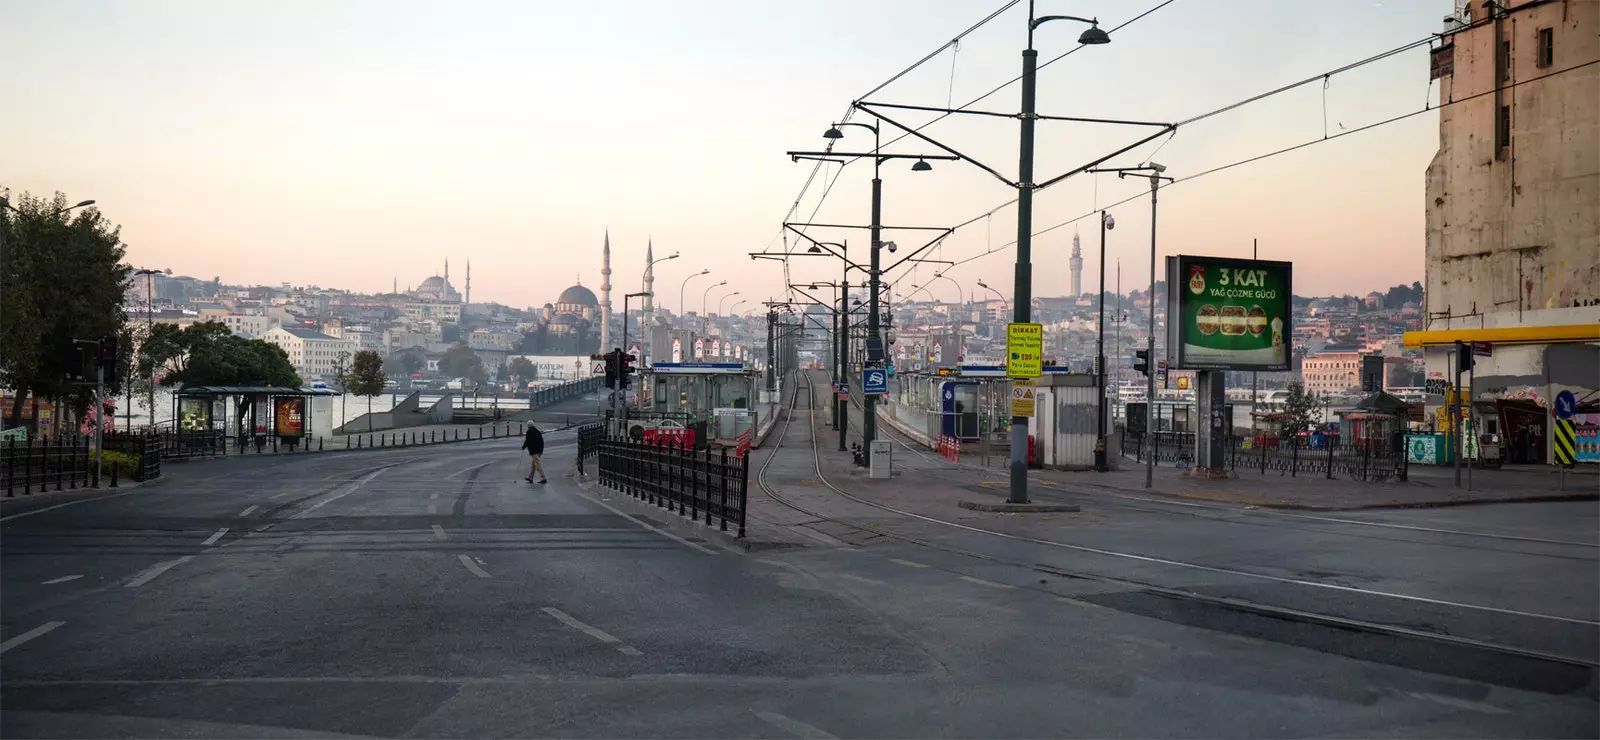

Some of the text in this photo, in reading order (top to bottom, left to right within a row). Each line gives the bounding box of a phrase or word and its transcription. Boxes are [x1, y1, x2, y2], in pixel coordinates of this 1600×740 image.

[1219, 268, 1268, 287] 3 KAT
[1210, 288, 1276, 299] YAĞ ÇÖZME GÜCÜ
